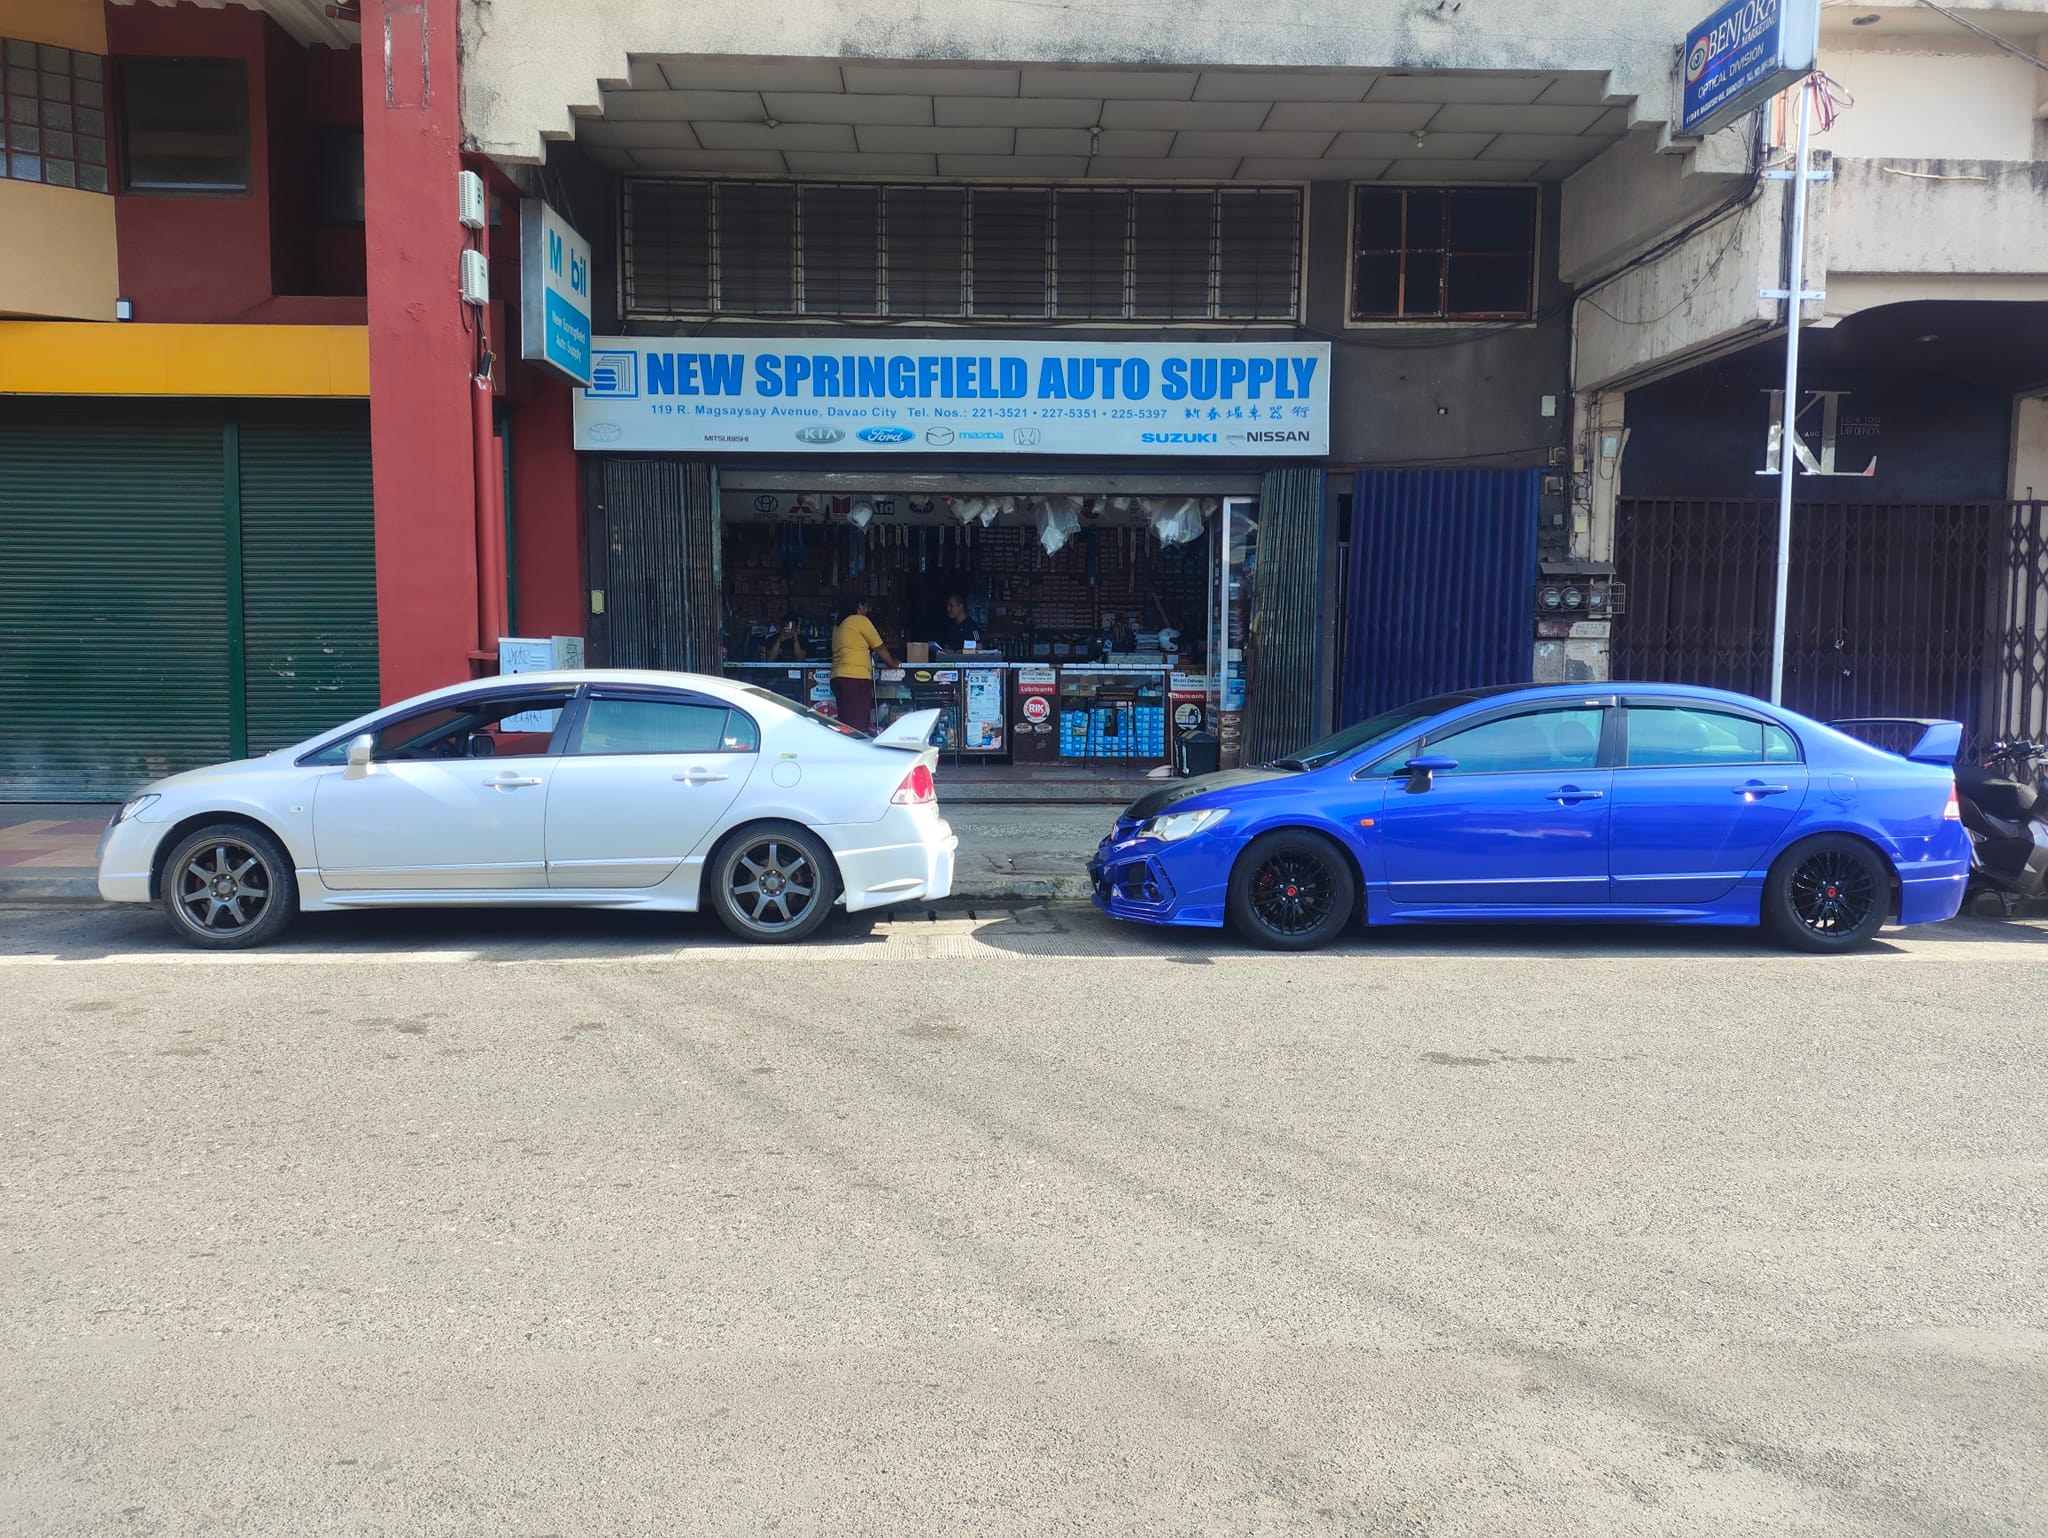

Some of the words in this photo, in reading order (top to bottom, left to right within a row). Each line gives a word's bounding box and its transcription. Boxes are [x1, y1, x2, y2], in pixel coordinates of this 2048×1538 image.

[1708, 0, 1777, 60] BENJORA
[1698, 71, 1727, 99] OPTICAL
[1729, 43, 1764, 76] DIVISION
[551, 309, 562, 327] New
[562, 316, 586, 345] Springfield
[556, 334, 566, 352] Auto
[566, 340, 582, 363] Supply
[648, 352, 745, 396] NEW
[755, 353, 1028, 399] SPRINGFIELD
[1037, 357, 1150, 400] AUTO
[1161, 357, 1318, 400] SUPPLY
[651, 405, 672, 415] 119
[677, 405, 690, 415] R.
[695, 405, 767, 420] Magsaysay
[771, 406, 823, 418] Avenue,
[828, 407, 868, 418] Davao
[872, 407, 897, 420] City
[908, 407, 930, 418] Tel.
[934, 408, 968, 418] Nos.:
[972, 408, 1028, 418] 221-3521
[1042, 408, 1098, 419] 227-5351
[1112, 409, 1167, 419] 225-5397
[704, 434, 750, 442] MITSUBISHI
[803, 428, 838, 440] KIA
[867, 427, 904, 442] Ford
[959, 431, 1004, 440] mazda
[1141, 432, 1218, 443] SUZUKI
[1246, 430, 1310, 442] NISSAN
